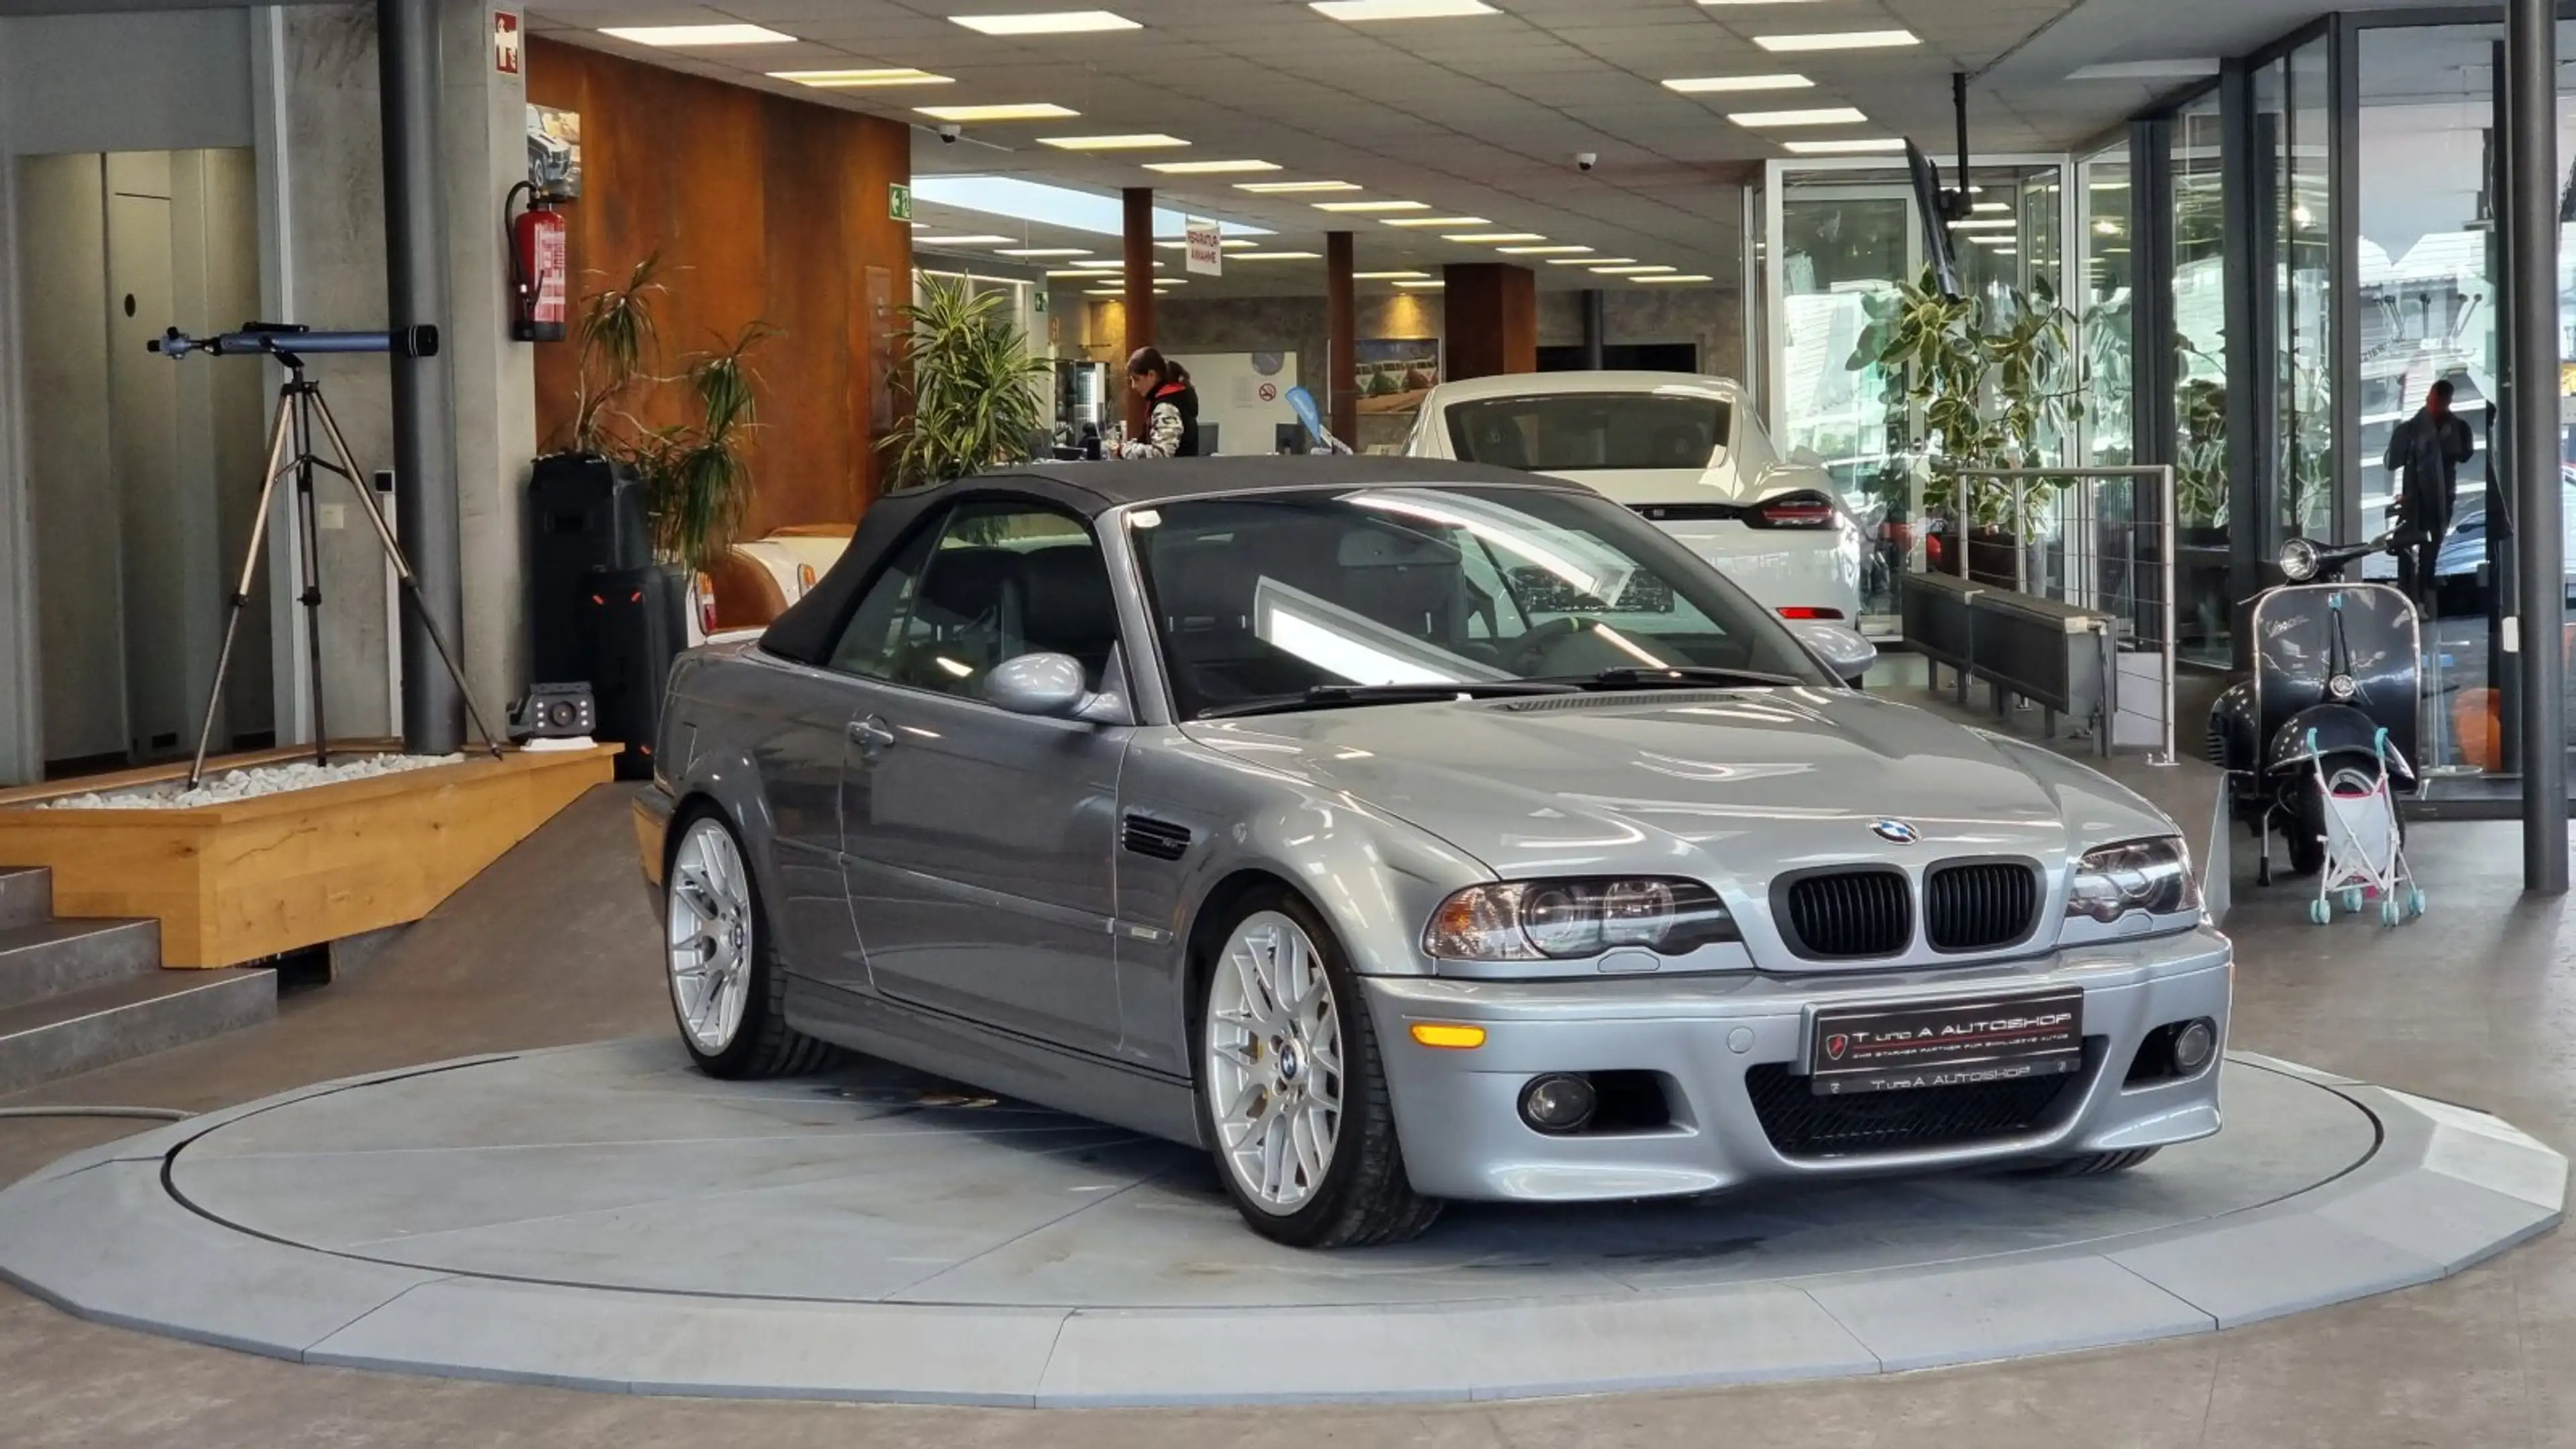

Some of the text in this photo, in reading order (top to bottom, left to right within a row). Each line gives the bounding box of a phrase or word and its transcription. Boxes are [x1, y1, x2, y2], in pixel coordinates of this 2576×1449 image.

[1852, 1032, 1870, 1042] T
[1918, 1026, 1934, 1038] A
[1941, 1012, 2072, 1036] AUTOSHOP
[1933, 1065, 2031, 1085] AUTOSHOP
